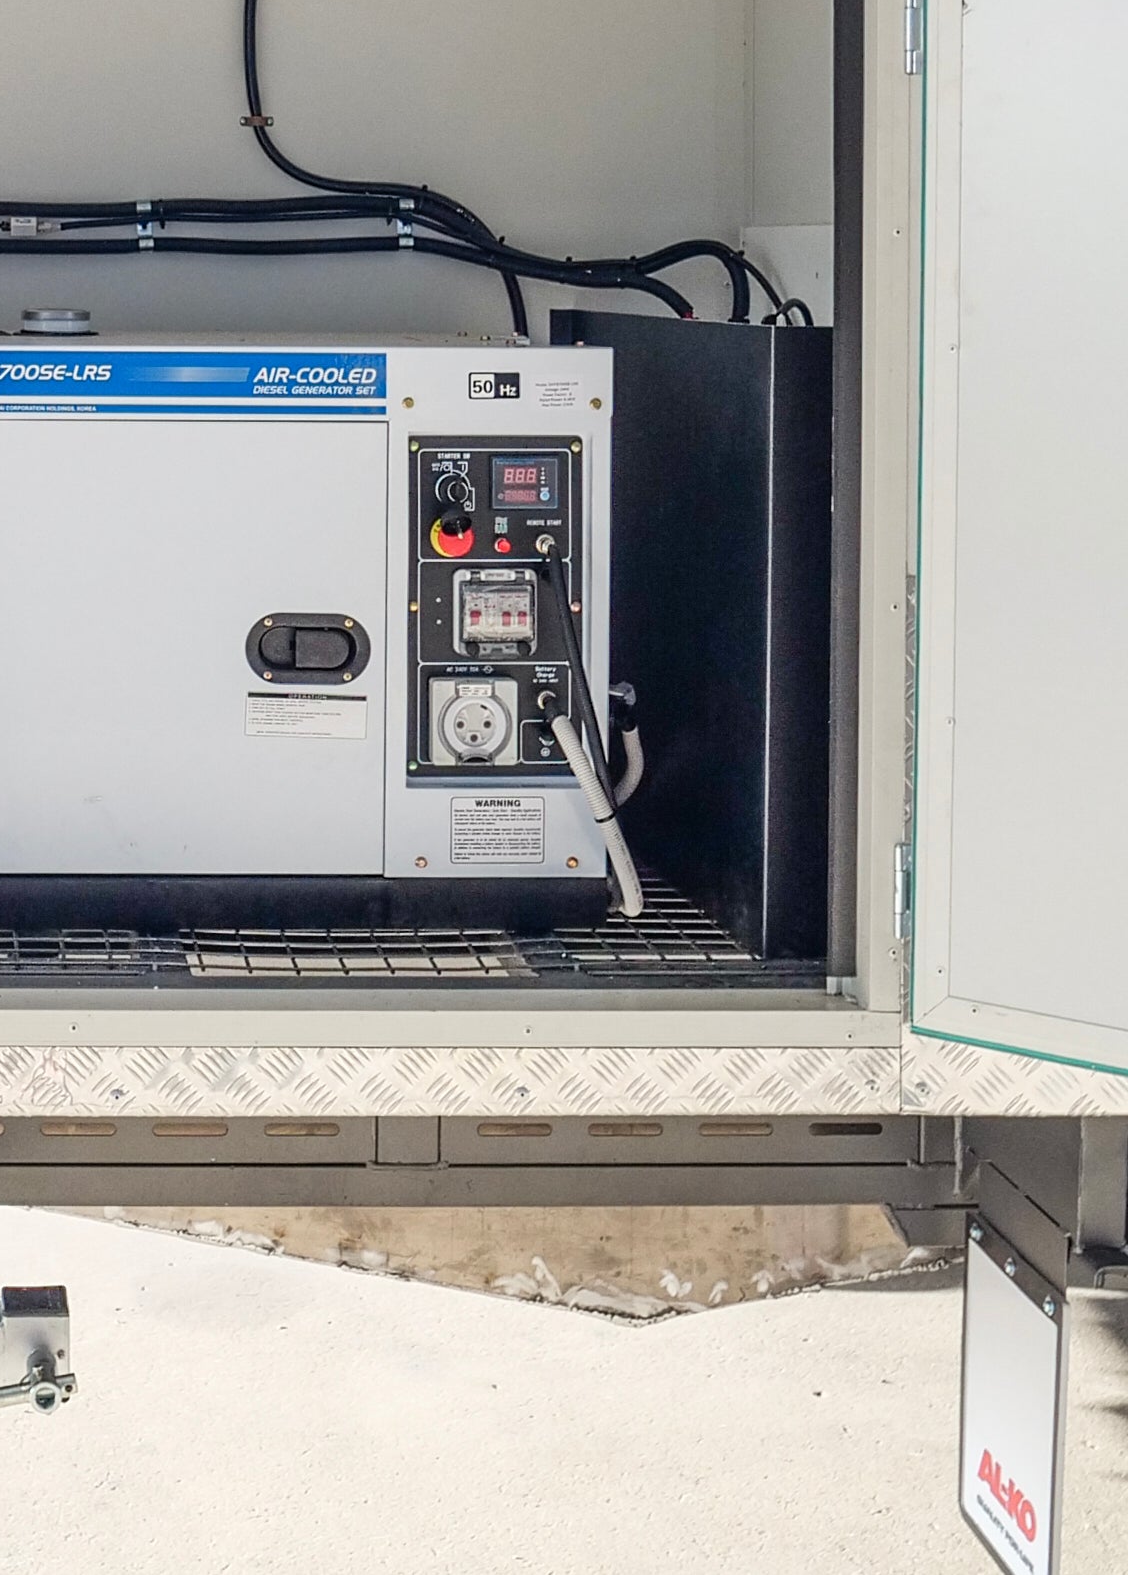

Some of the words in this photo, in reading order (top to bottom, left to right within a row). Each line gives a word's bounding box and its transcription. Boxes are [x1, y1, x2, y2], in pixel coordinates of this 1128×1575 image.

[252, 367, 377, 384] AIR-COOLED
[252, 385, 288, 395] DIESEL
[291, 385, 353, 395] GENERATOR
[355, 386, 377, 395] SET
[472, 379, 493, 394] 50
[499, 383, 518, 397] Hz
[474, 799, 521, 807] WARNING
